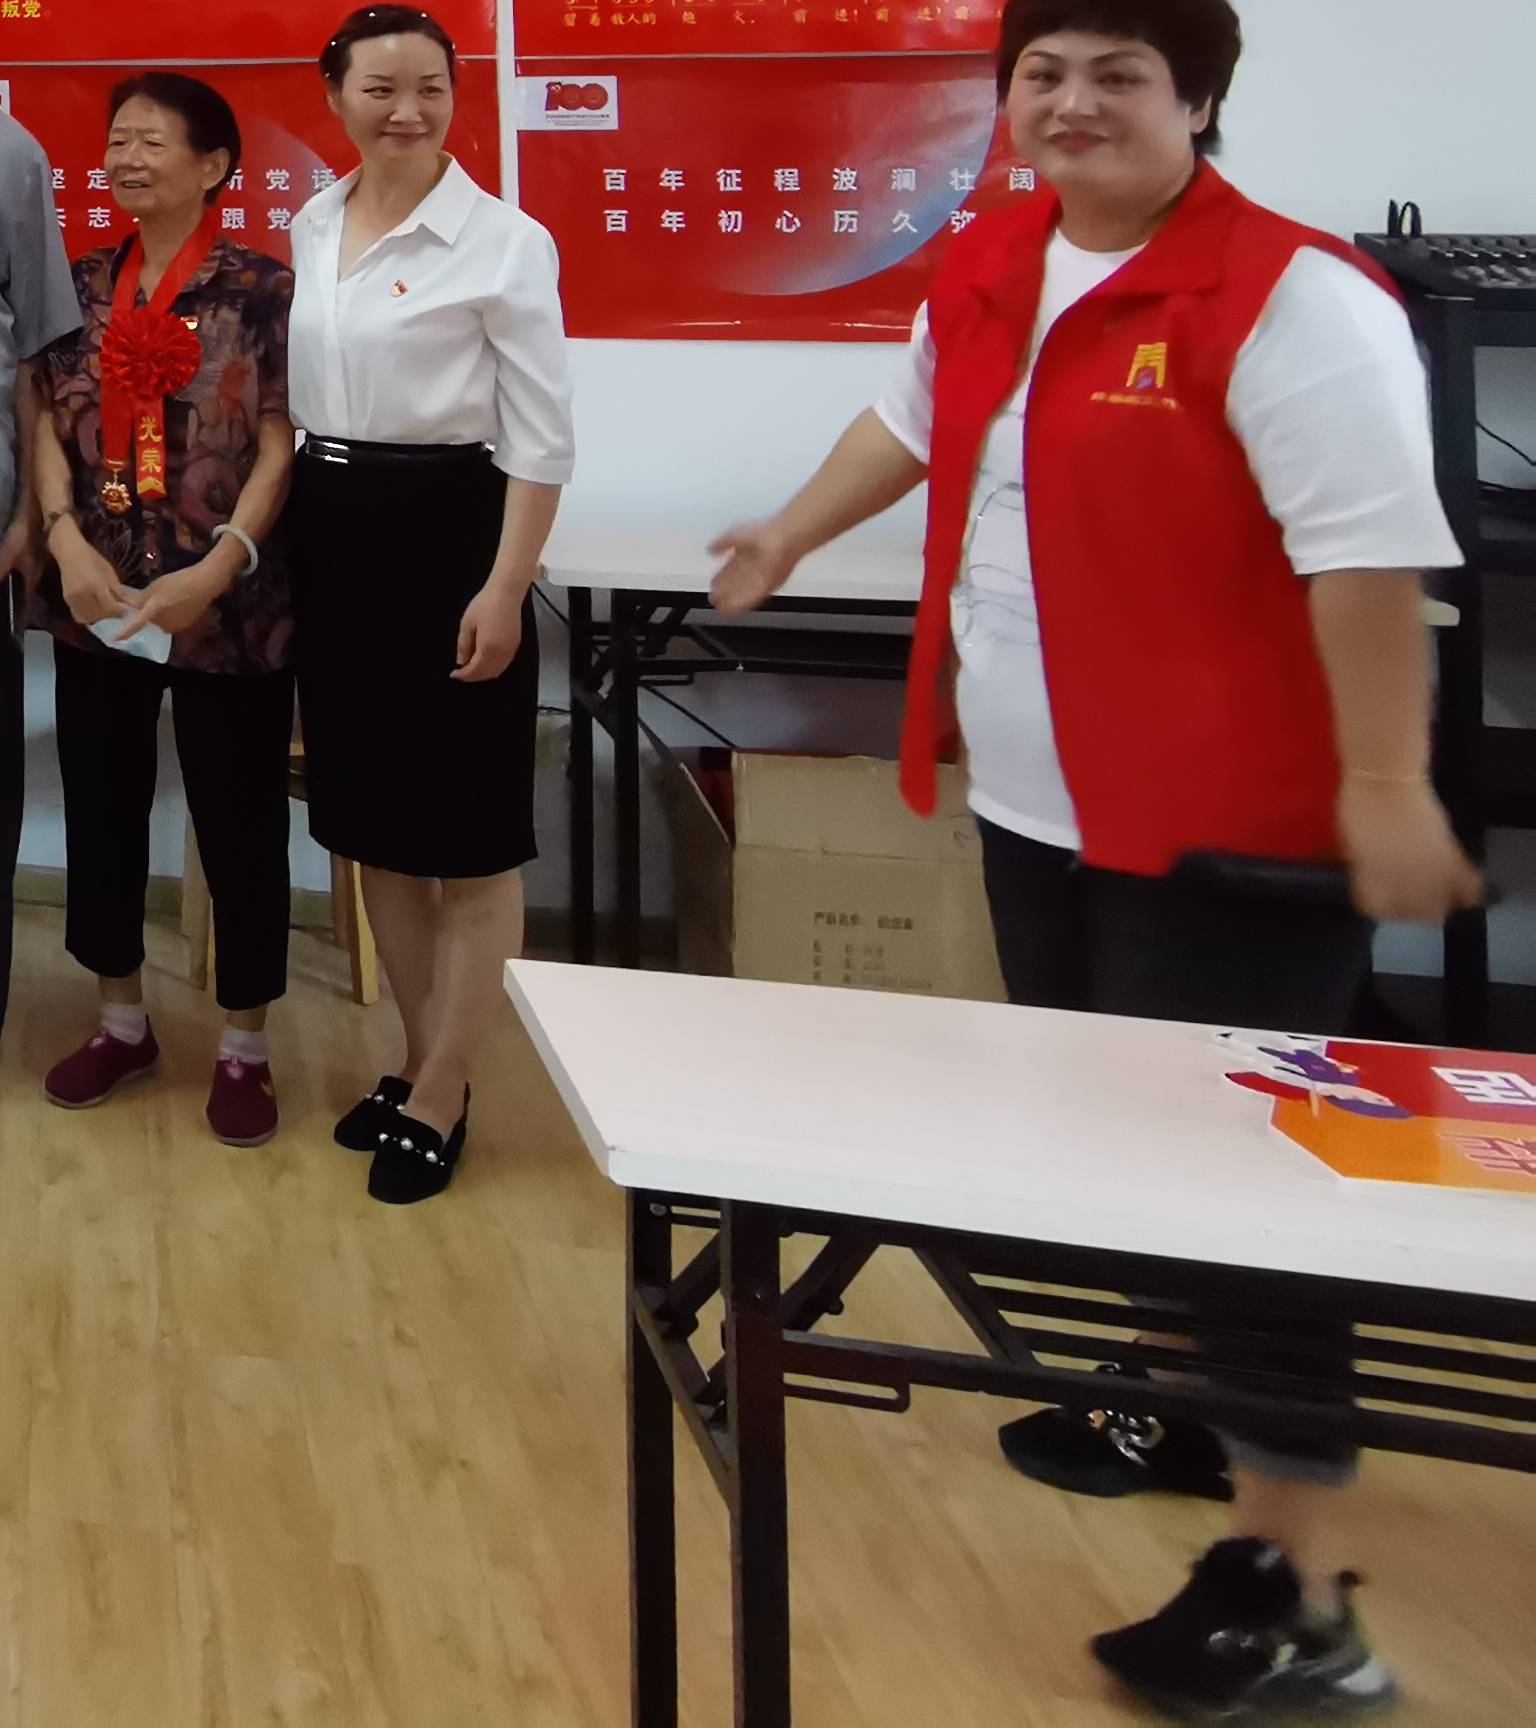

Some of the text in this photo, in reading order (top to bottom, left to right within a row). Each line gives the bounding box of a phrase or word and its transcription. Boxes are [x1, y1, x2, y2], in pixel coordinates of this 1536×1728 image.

[603, 167, 1036, 192] 百年征程波澜壮阔
[140, 415, 164, 473] 光荣
